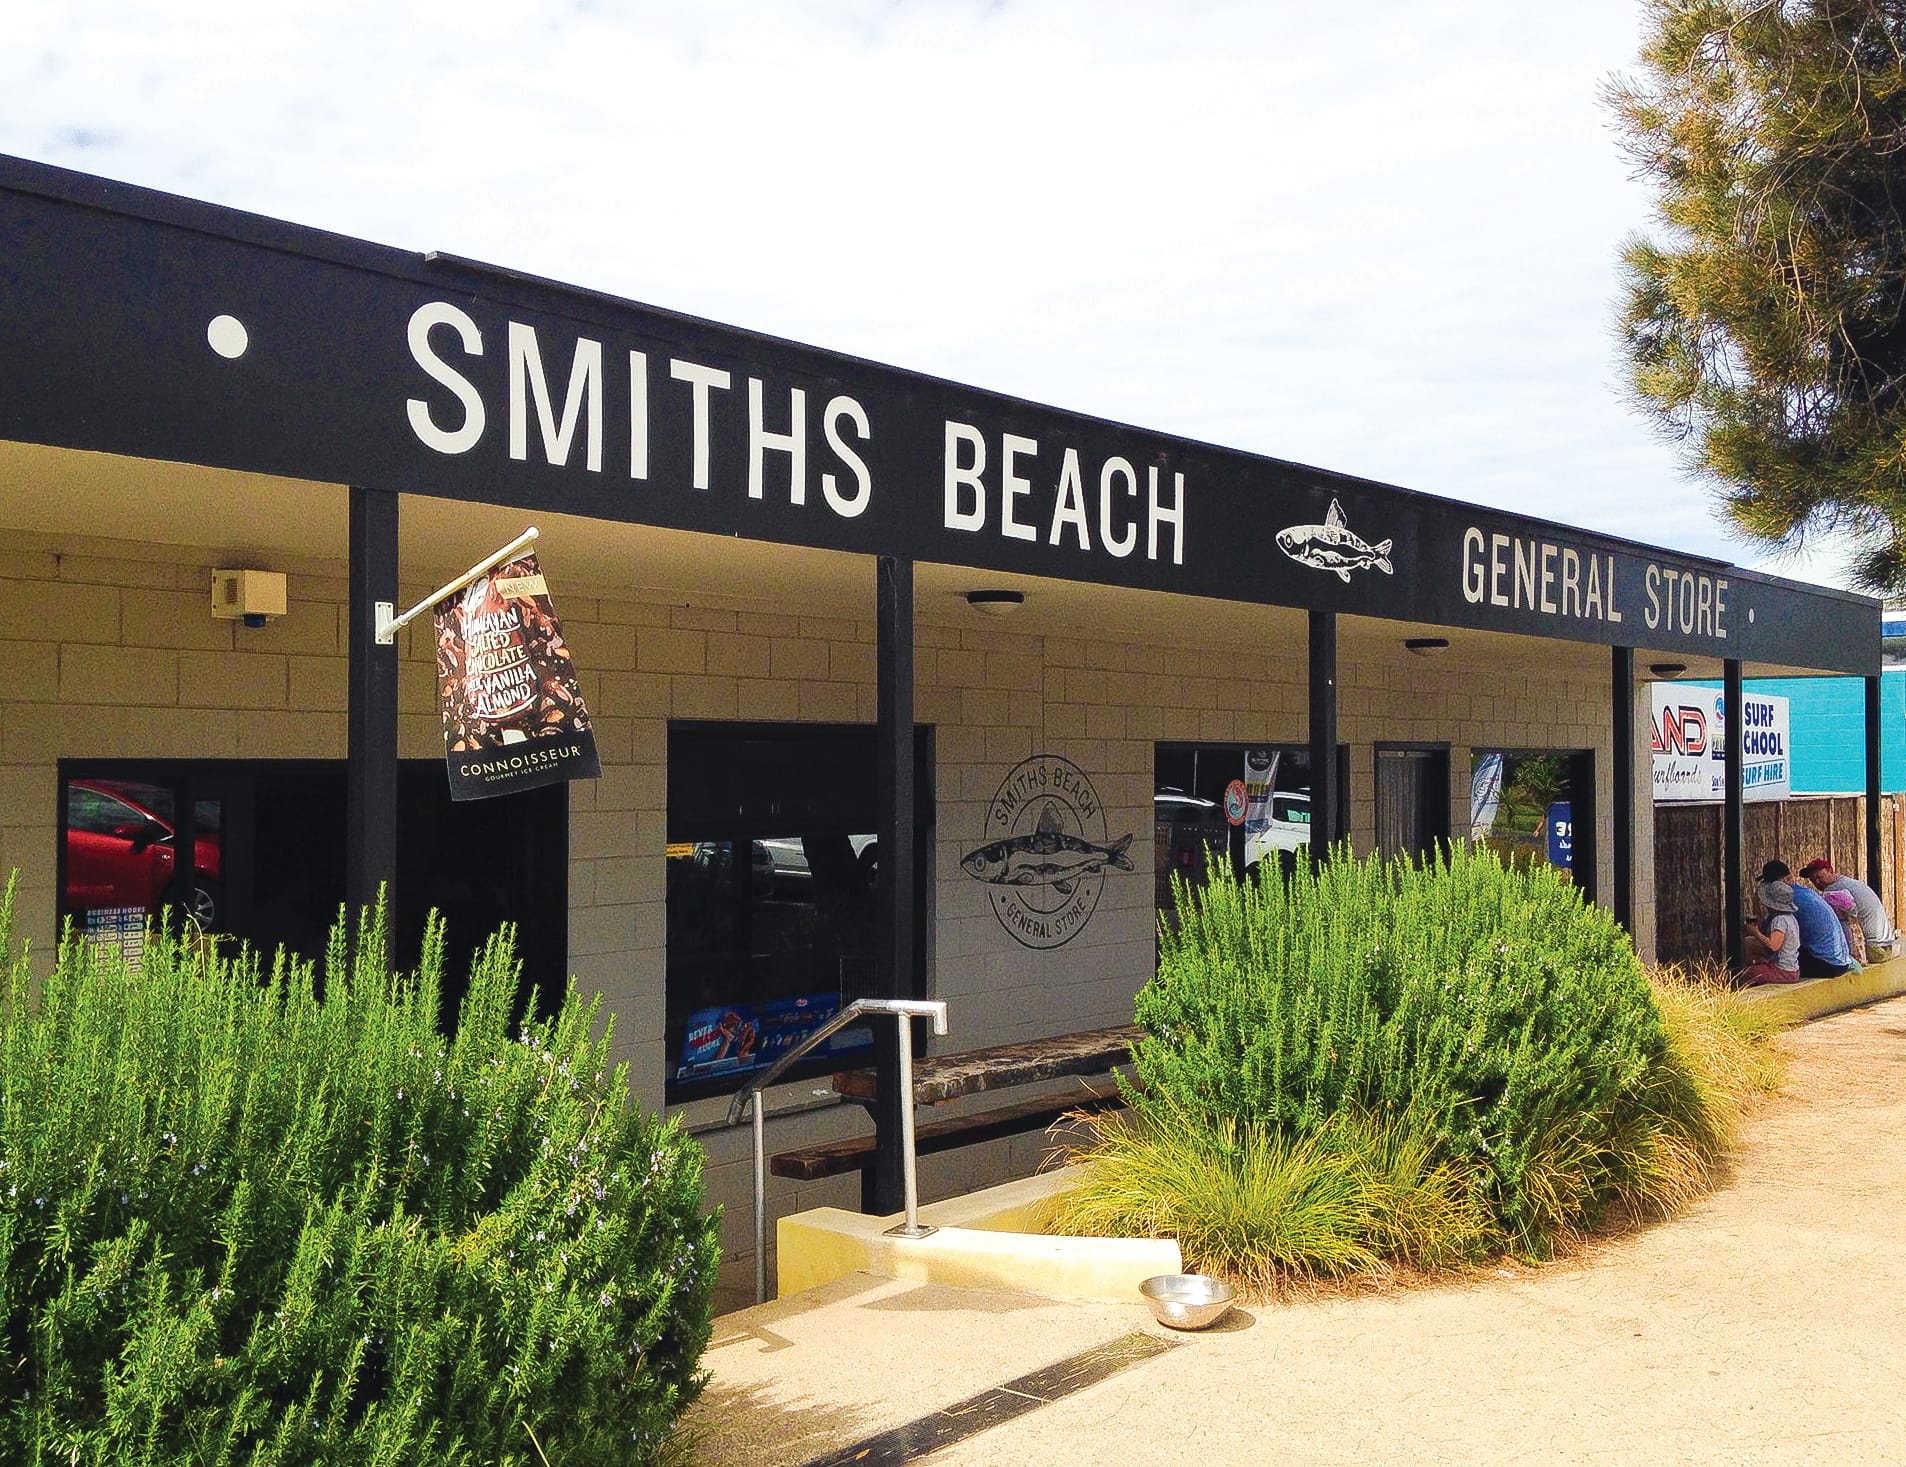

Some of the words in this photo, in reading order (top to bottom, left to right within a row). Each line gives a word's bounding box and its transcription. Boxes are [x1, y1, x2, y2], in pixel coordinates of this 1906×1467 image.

[406, 301, 872, 519] SMITHS
[944, 420, 1185, 566] BEACH
[505, 579, 539, 593] NEW
[1462, 526, 1622, 623] GENERAL
[1644, 564, 1729, 639] STORE
[482, 663, 537, 695] VANILLA
[473, 683, 531, 719] ALMOND
[1744, 702, 1774, 728] SURF
[1743, 730, 1783, 756] CHOOL
[460, 745, 581, 777] CONNOISSEUR
[484, 771, 518, 782] GOURMET
[521, 768, 532, 776] ICE
[535, 762, 559, 773] CREAM
[1653, 760, 1702, 791] urfboards
[1764, 762, 1783, 782] HIRE
[995, 765, 1048, 826] SMITHS
[1053, 767, 1097, 819] BEACH
[1006, 902, 1052, 938] GENERAL
[1055, 897, 1086, 935] STORE
